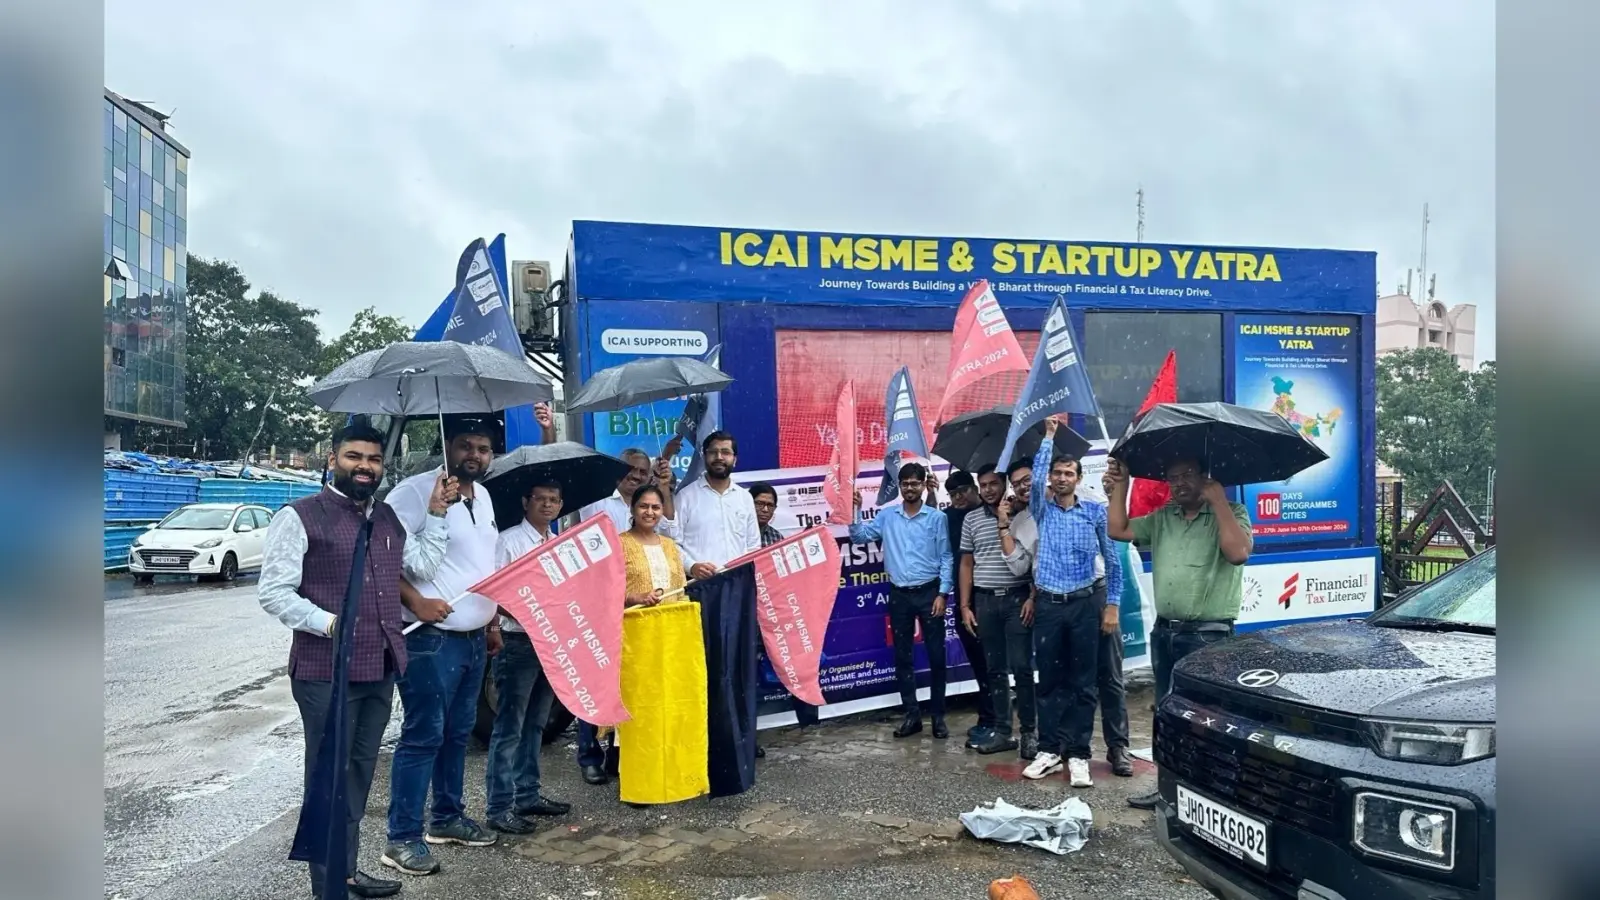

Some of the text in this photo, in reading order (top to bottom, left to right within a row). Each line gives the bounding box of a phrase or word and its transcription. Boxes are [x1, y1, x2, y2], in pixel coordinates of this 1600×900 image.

[720, 232, 1282, 281] ICAI MSME & STARTUP YATRA
[819, 278, 862, 290] Journey
[865, 279, 910, 290] Towards
[913, 280, 955, 292] Building
[958, 283, 964, 291] a
[999, 282, 1031, 292] Bharat
[1033, 283, 1072, 295] through
[1075, 284, 1118, 294] Financial
[1120, 286, 1126, 294] &
[1129, 286, 1145, 295] Tax
[1148, 286, 1184, 297] Literacy
[1186, 288, 1212, 297] Drive.
[1240, 325, 1351, 336] ICAI MSME & STARTUP
[608, 336, 702, 348] ICAI SUPPORTING
[1279, 340, 1314, 349] YATRA
[984, 348, 1009, 365] 2024
[1048, 386, 1071, 404] 2024
[1282, 492, 1302, 500] DAYS
[1258, 498, 1279, 516] 100
[1282, 500, 1337, 510] PROGRAMMES
[1282, 511, 1307, 520] CITIES
[1306, 574, 1363, 592] Financial
[857, 592, 872, 608] 3rd
[1306, 590, 1367, 604] Tax Literacy
[784, 623, 794, 631] &
[787, 593, 813, 653] ICAI MSME
[566, 600, 610, 669] ICAI MSME
[755, 572, 801, 690] STARTUP YATRA 2024
[1121, 632, 1135, 642] CAI
[518, 585, 560, 644] STARTUP
[553, 644, 582, 689] YATRA
[575, 686, 599, 717] 2024
[567, 637, 579, 650] &
[828, 663, 865, 674] Organised
[866, 660, 877, 668] by:
[831, 673, 856, 682] MSME
[857, 670, 871, 678] and
[824, 683, 855, 692] Literacy
[1182, 710, 1294, 752] EXTER
[1185, 796, 1266, 857] JH01FK6082
